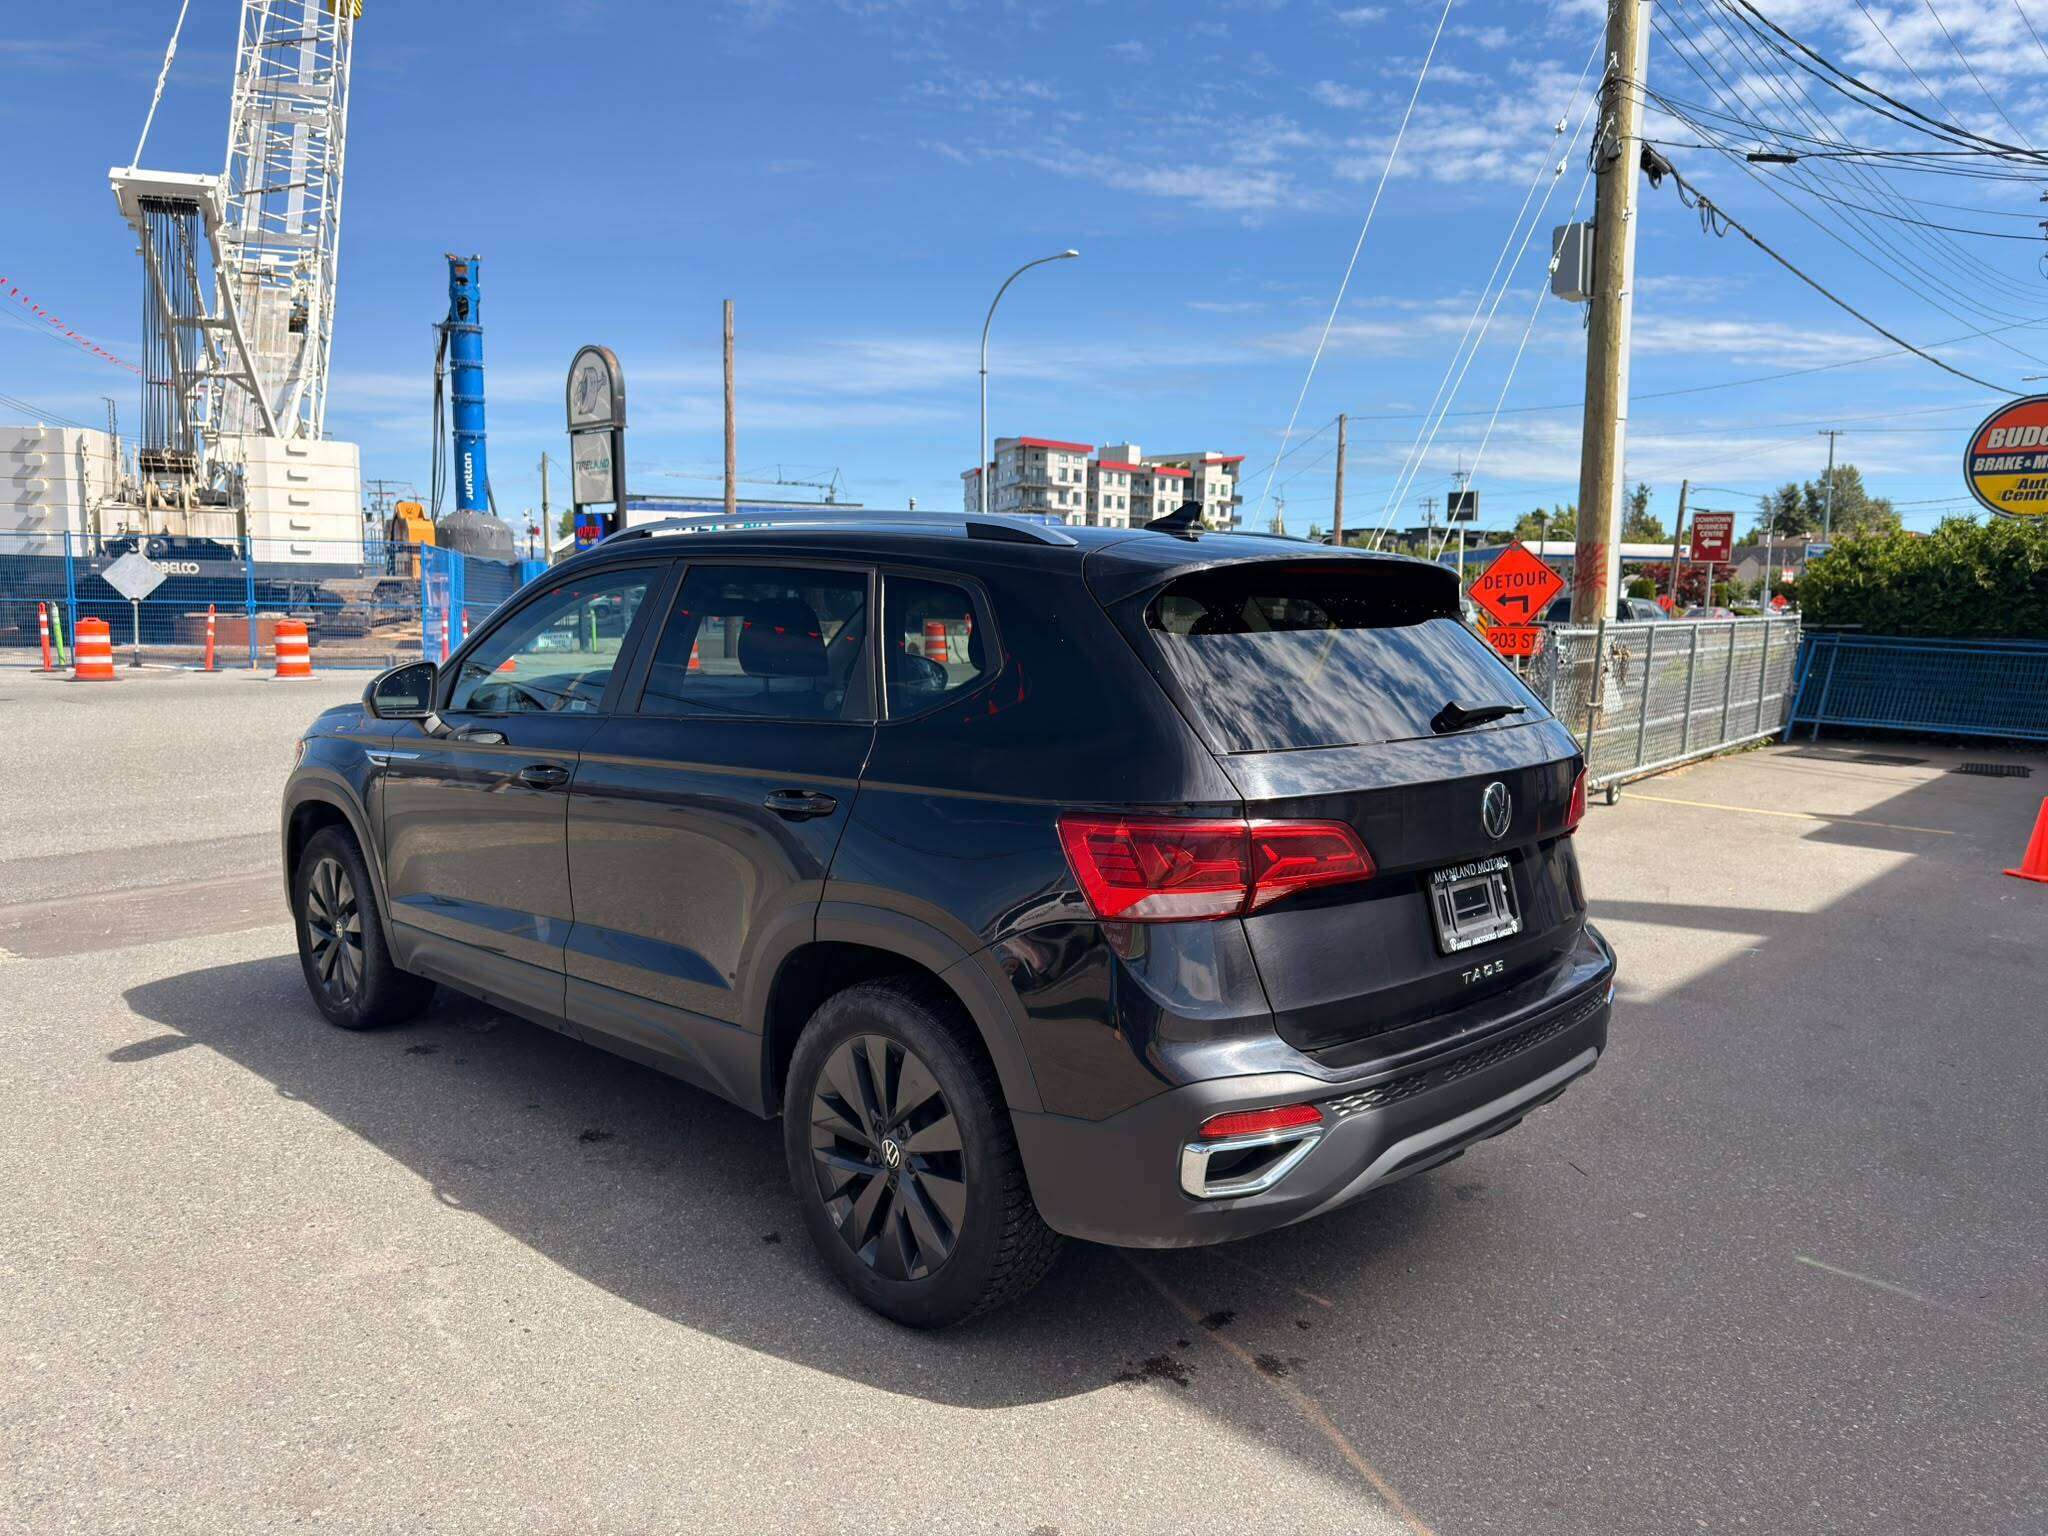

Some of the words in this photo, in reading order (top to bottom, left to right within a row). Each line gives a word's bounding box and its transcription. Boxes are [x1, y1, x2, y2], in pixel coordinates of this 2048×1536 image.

[1974, 456, 2024, 472] BRAKE
[2024, 459, 2032, 468] &
[2032, 454, 2048, 470] M
[2017, 478, 2048, 490] Aut
[2001, 489, 2048, 502] Centr
[1699, 530, 1725, 538] CENTRE
[151, 561, 200, 575] OBELCO
[1484, 570, 1548, 590] DETOUR
[1490, 632, 1517, 649] 203
[1521, 633, 1538, 649] ST
[1434, 863, 1477, 884] MAINLAND
[1477, 856, 1509, 874] MOTORS
[1462, 959, 1505, 984] TAOS
